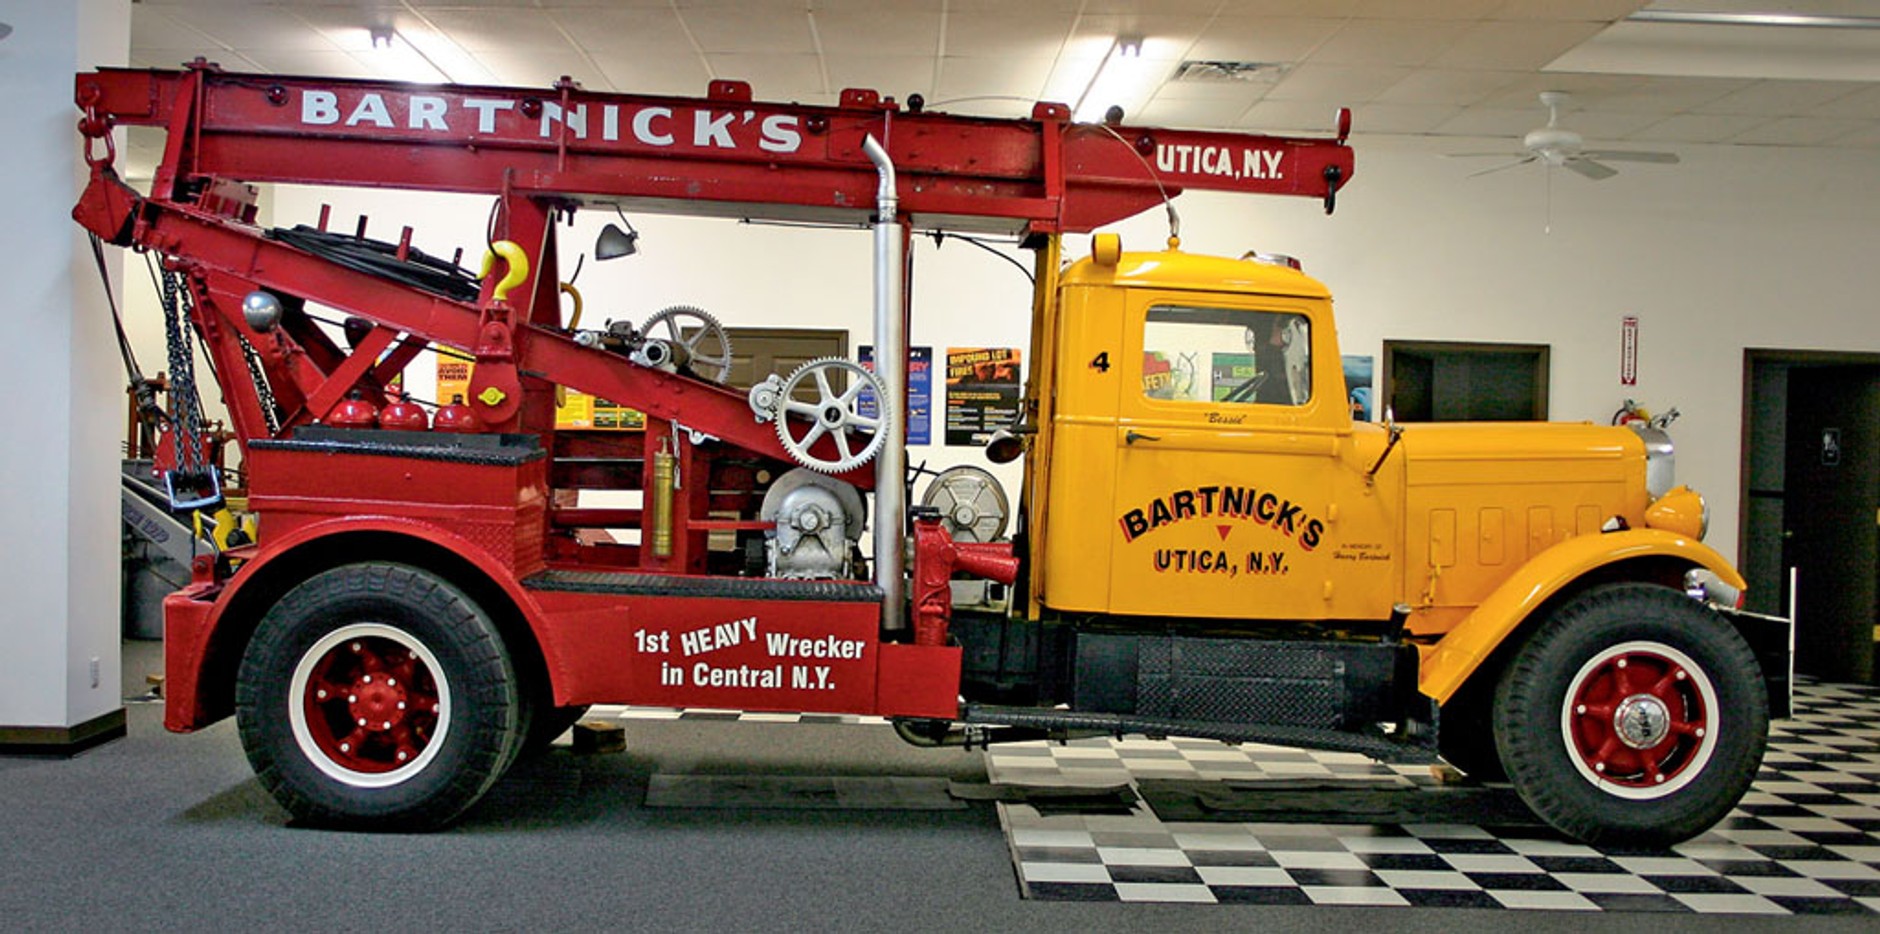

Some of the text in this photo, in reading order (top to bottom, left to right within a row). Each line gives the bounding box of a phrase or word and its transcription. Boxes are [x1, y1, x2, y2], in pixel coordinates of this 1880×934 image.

[300, 90, 802, 153] BARTNICK'S
[1089, 351, 1110, 373] 4
[1119, 486, 1325, 551] BARTNICK'S
[1153, 549, 1289, 578] UTICA, N.Y.
[634, 617, 865, 659] 1st HEAVY Wrecker
[661, 662, 835, 690] in Central N.Y.
